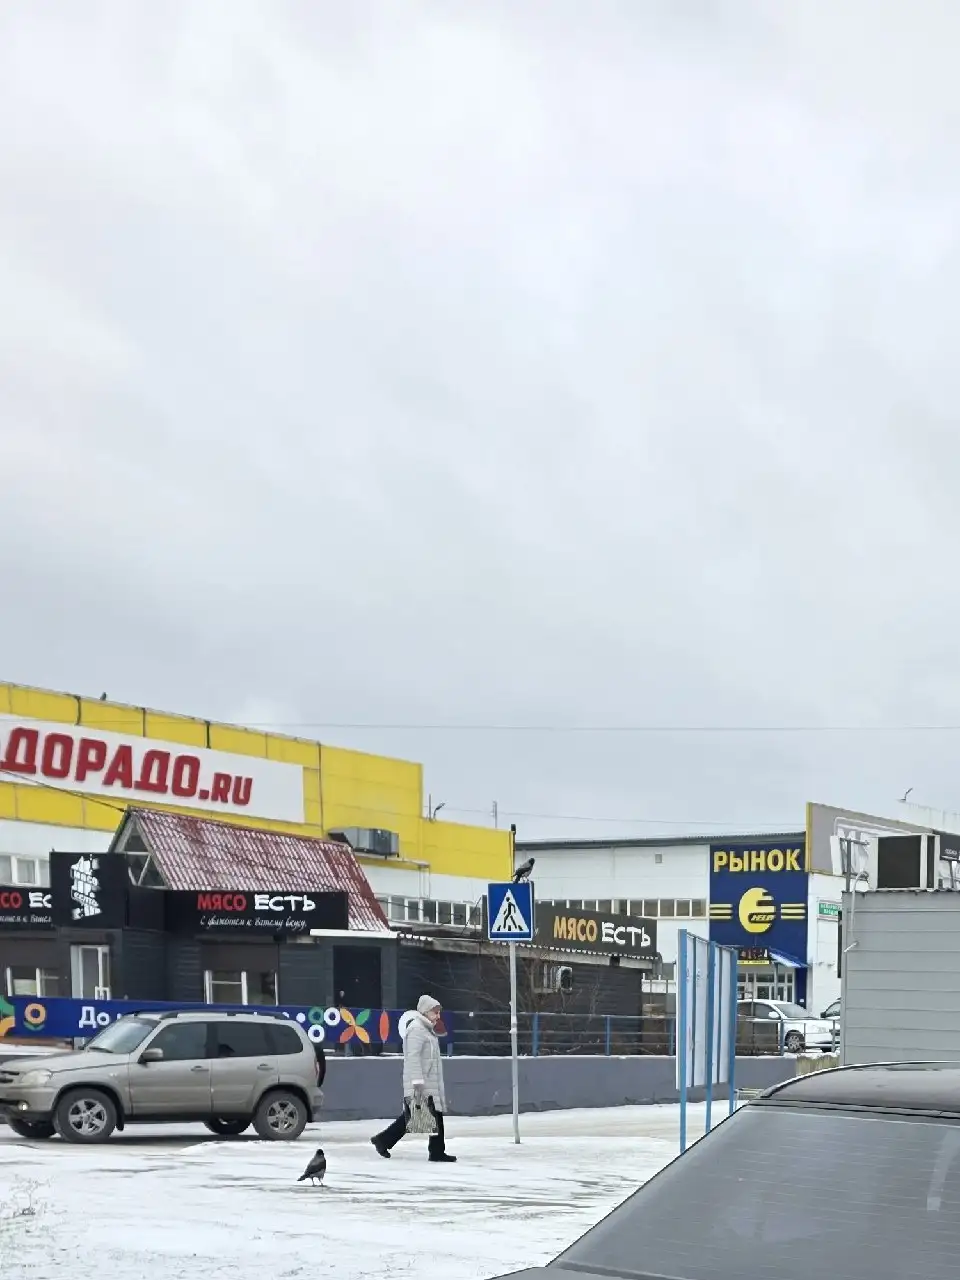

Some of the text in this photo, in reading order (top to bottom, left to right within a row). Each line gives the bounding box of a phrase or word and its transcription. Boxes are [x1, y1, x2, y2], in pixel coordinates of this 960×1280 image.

[713, 849, 801, 872] РЫНОК
[197, 893, 317, 912] МЯСО ЕСТЬ
[553, 915, 651, 948] МЯСО ЕСТЬ
